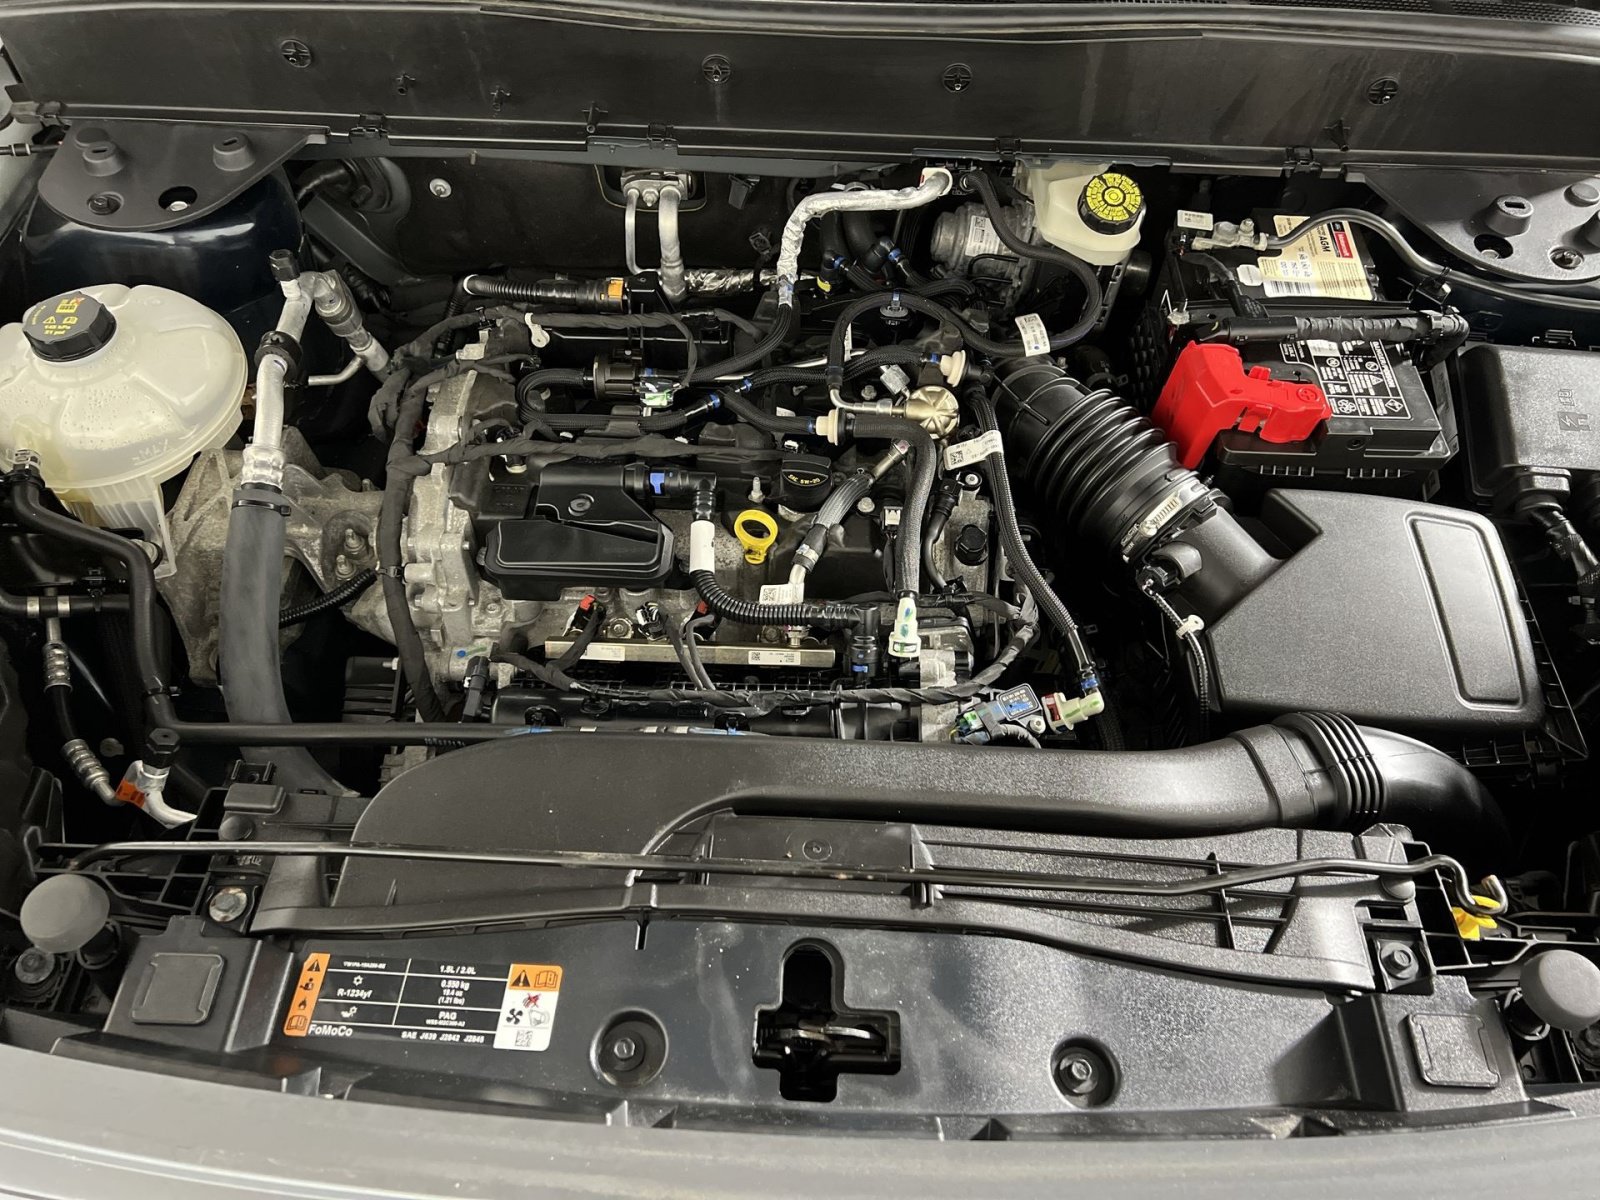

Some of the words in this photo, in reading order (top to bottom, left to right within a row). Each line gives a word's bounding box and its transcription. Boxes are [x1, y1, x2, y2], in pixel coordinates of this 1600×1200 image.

[1319, 236, 1331, 252] AGM
[460, 965, 476, 975] 2.0L
[336, 988, 373, 1000] R-1234yf
[438, 1011, 458, 1020] PAG
[308, 1024, 354, 1037] FoMoCo
[401, 1031, 417, 1039] SAE
